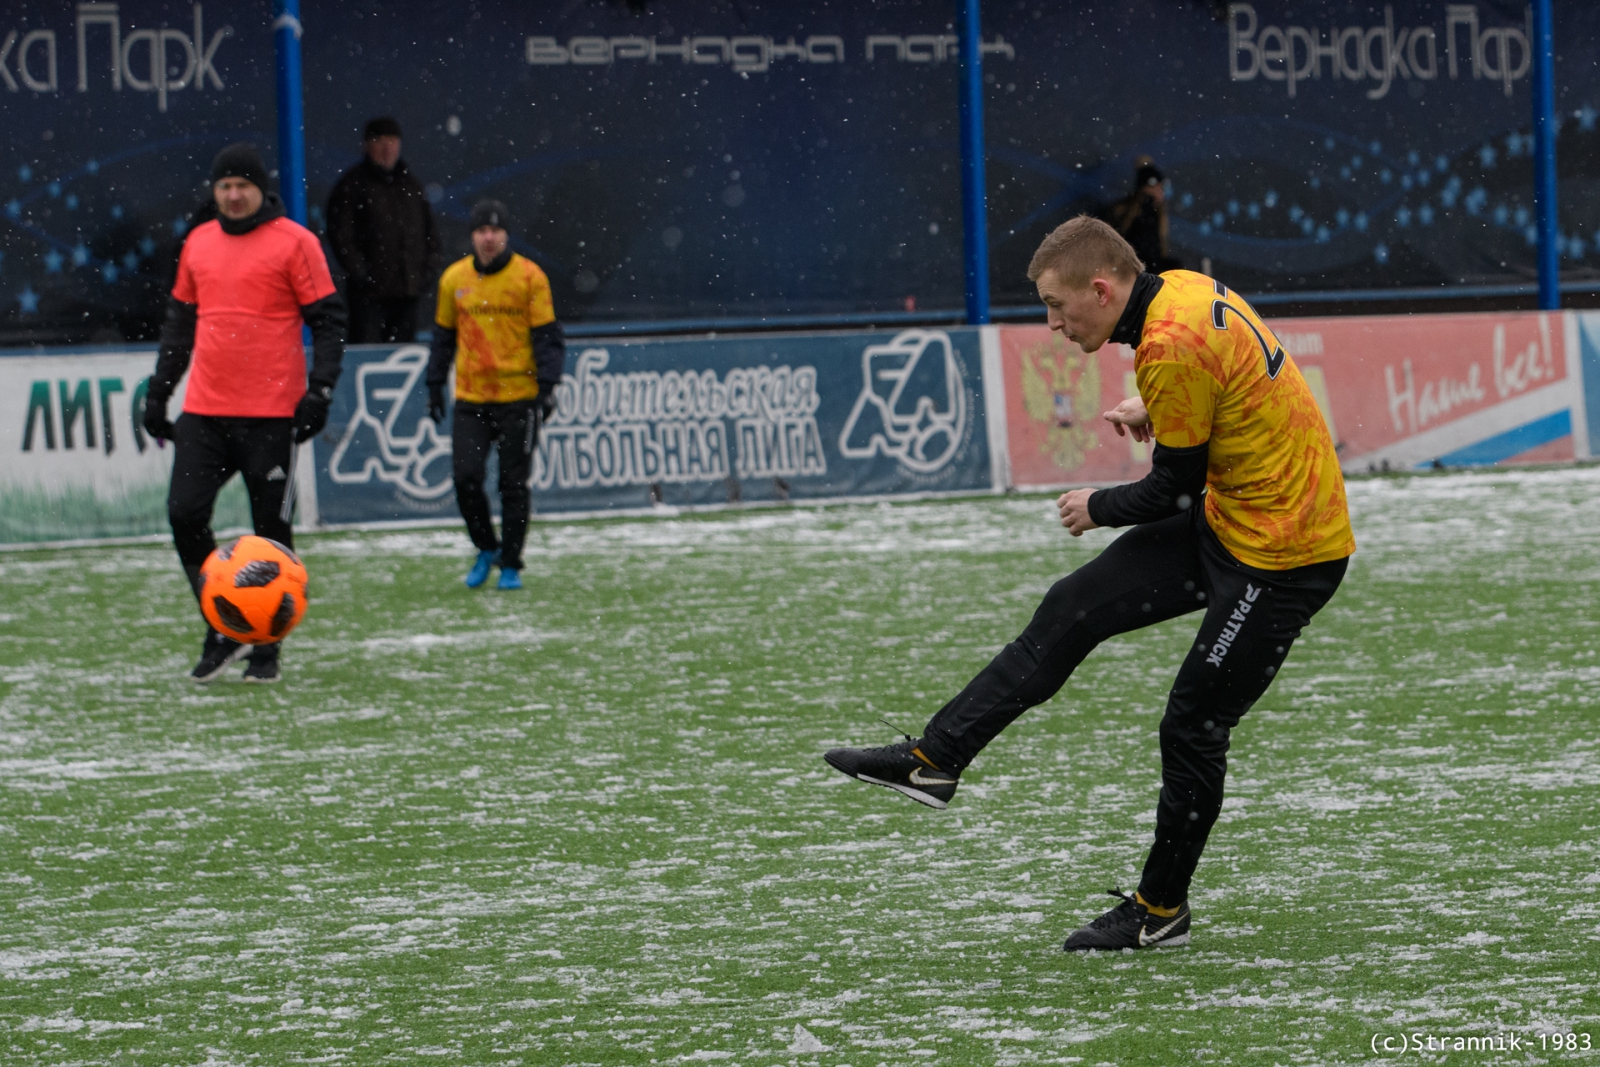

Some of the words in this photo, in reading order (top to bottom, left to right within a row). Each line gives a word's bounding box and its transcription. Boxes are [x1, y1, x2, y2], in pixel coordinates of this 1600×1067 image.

[1229, 3, 1438, 99] Вернадка
[1446, 4, 1532, 97] Пар
[526, 419, 730, 490] УТБОЛЬНАЯ
[734, 415, 827, 480] ЛИГА
[1206, 600, 1252, 668] PATRICK
